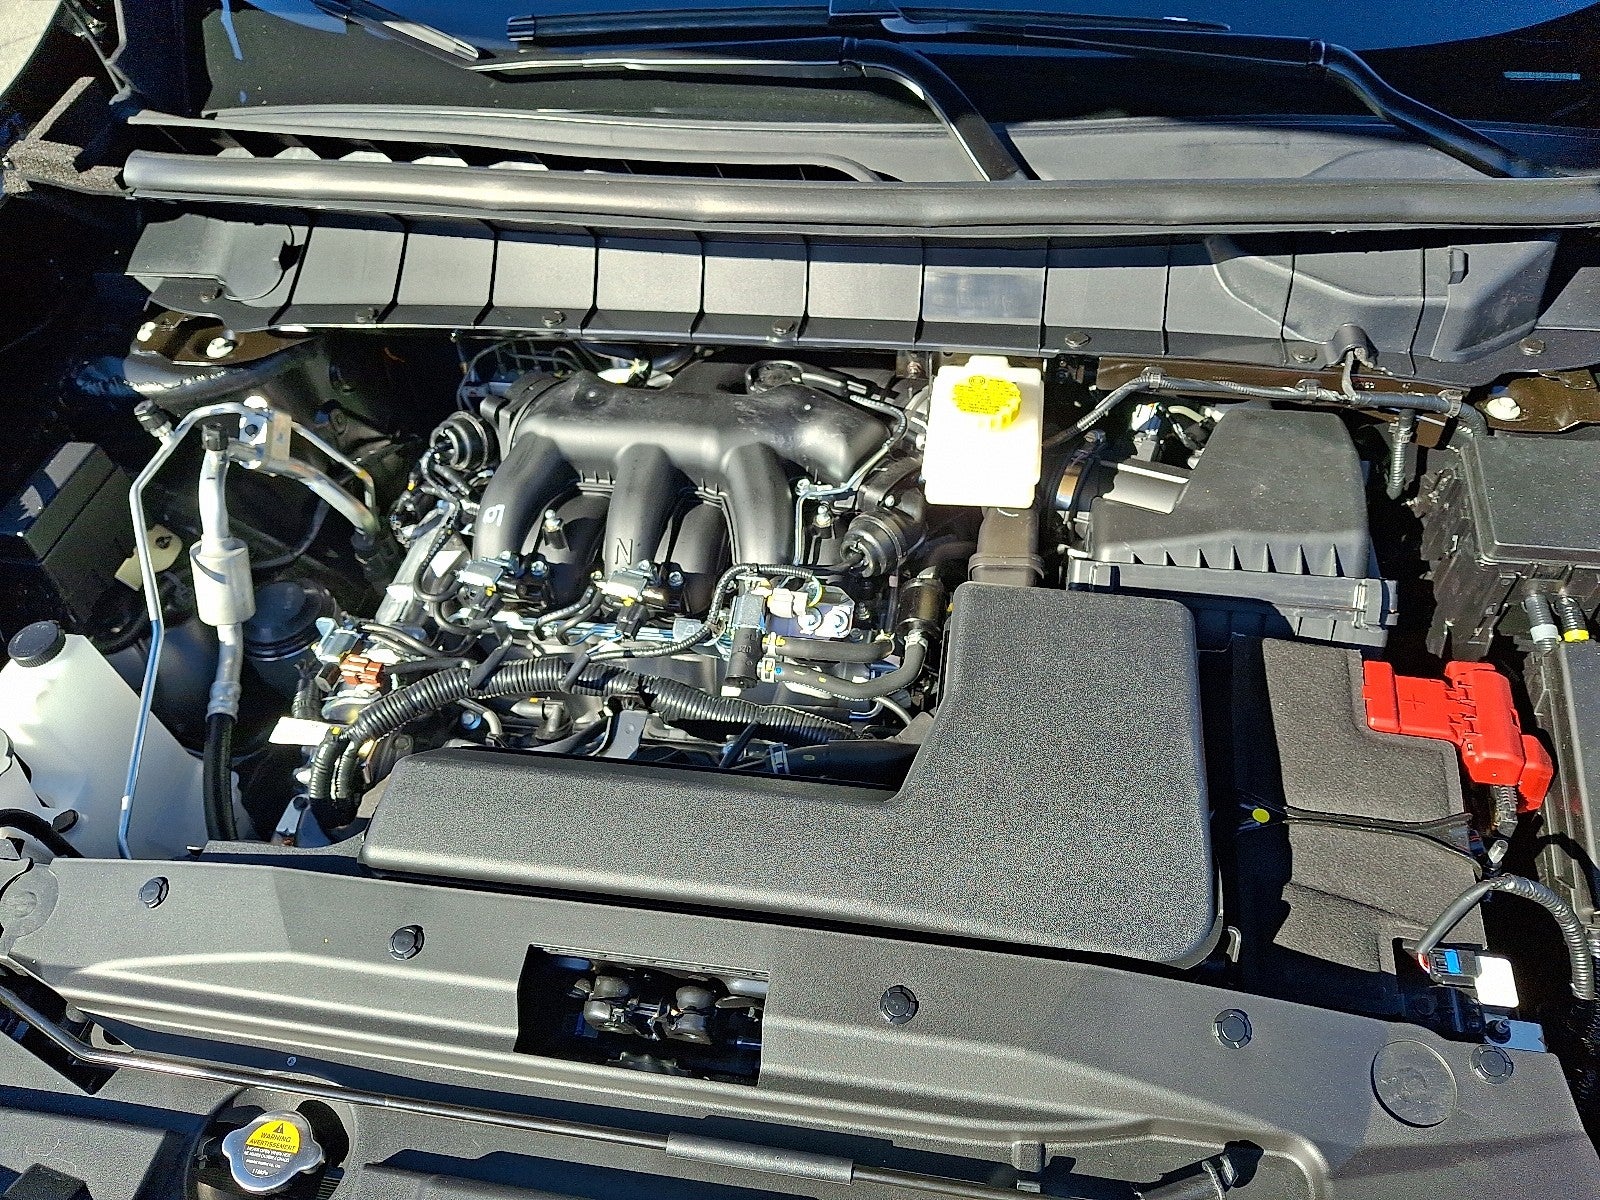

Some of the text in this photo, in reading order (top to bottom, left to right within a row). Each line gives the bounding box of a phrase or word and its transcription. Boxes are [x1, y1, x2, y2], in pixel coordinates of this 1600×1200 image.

[614, 537, 633, 565] N
[260, 1132, 291, 1142] WARNING
[249, 1139, 296, 1150] AVERTISSEMENT
